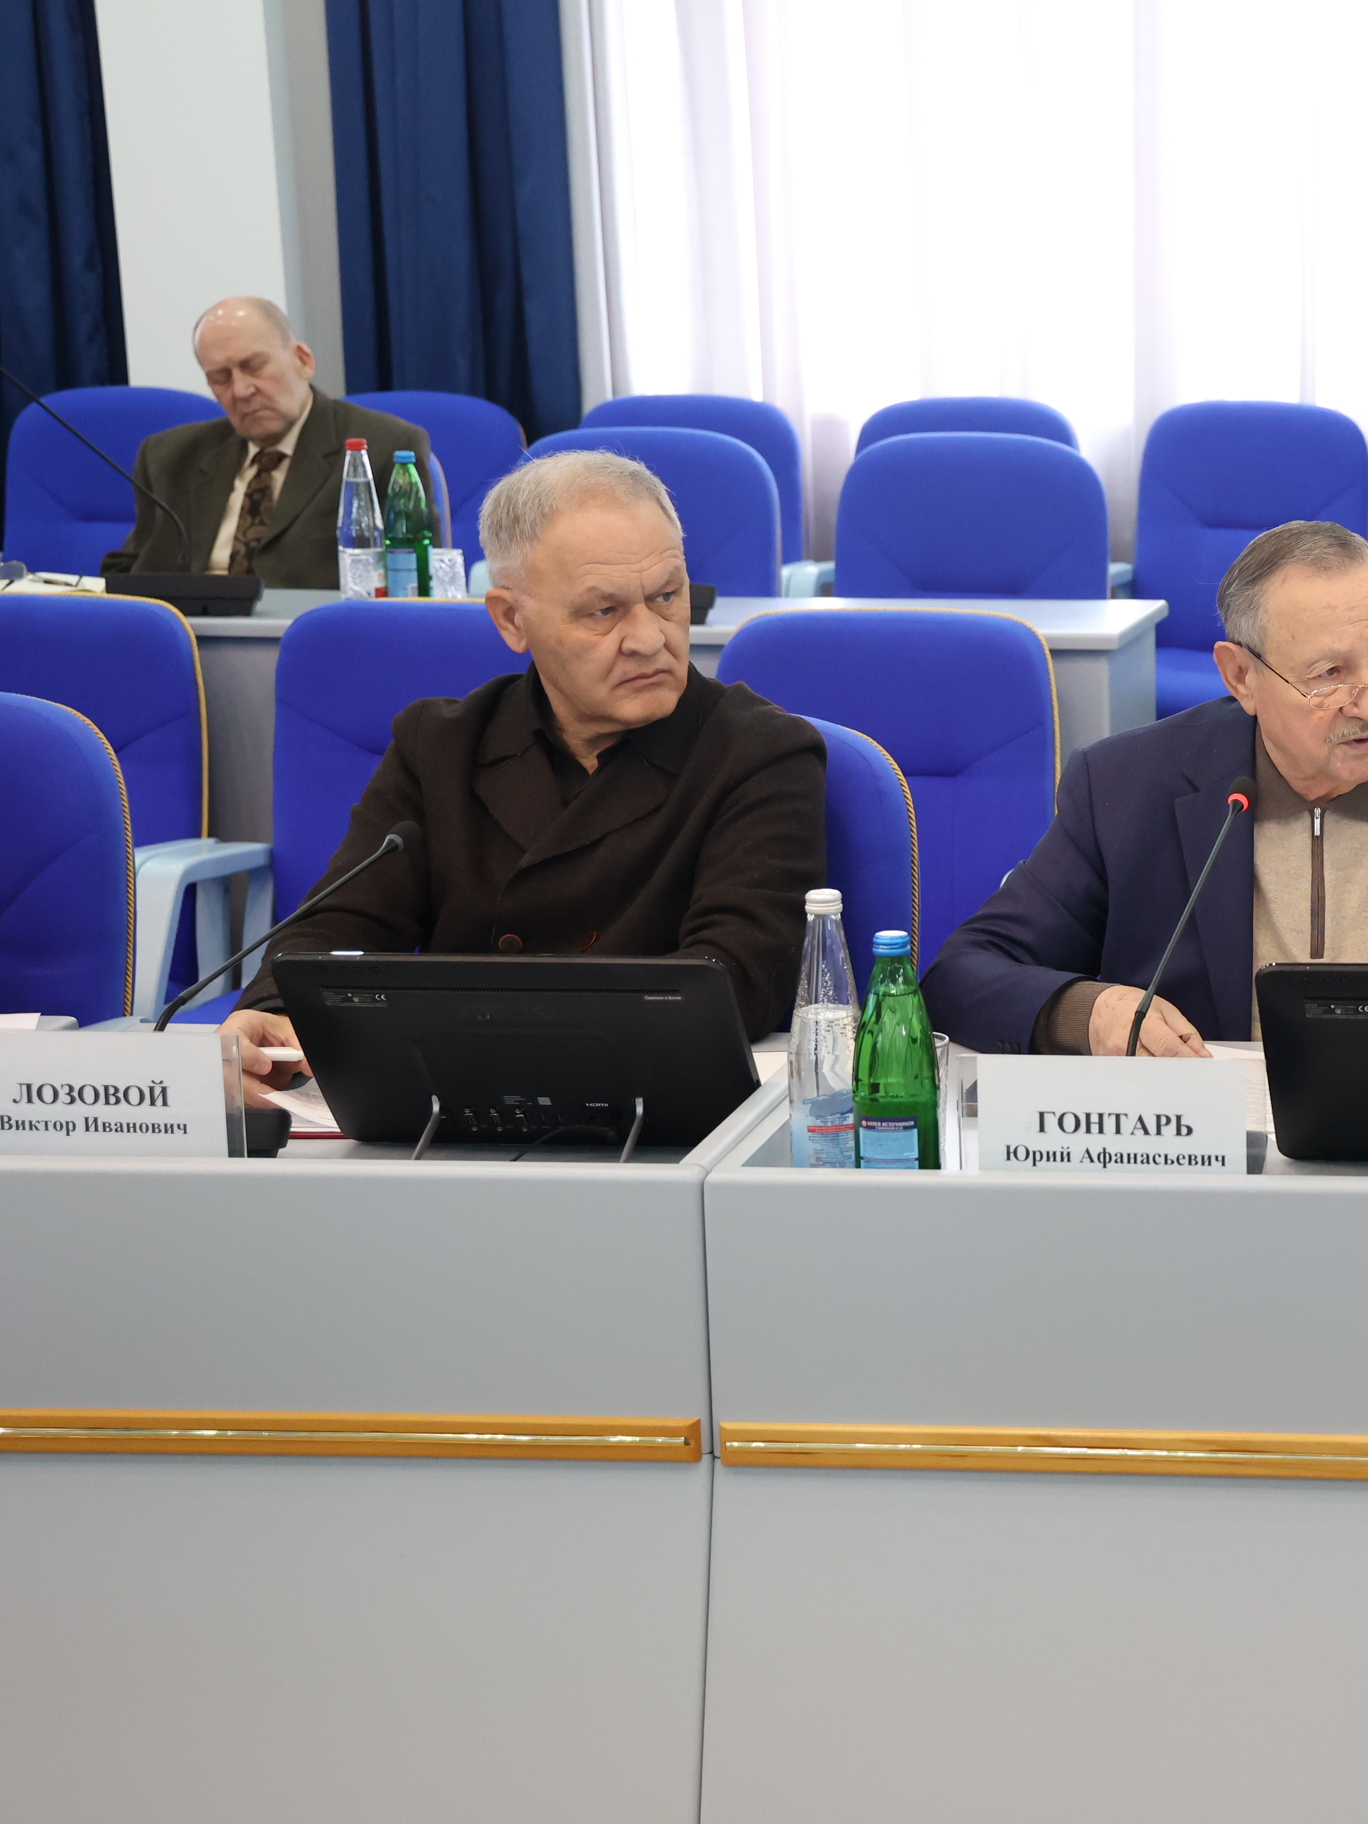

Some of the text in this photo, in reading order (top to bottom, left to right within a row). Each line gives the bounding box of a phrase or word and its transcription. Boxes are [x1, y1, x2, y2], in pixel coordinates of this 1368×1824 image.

[12, 1079, 171, 1108] ЛОЗОВОЙ
[0, 1114, 189, 1137] Виктор Иванович
[1036, 1110, 1194, 1137] ГОНТАРЬ
[1004, 1143, 1227, 1169] Юрий Афанасьевич
